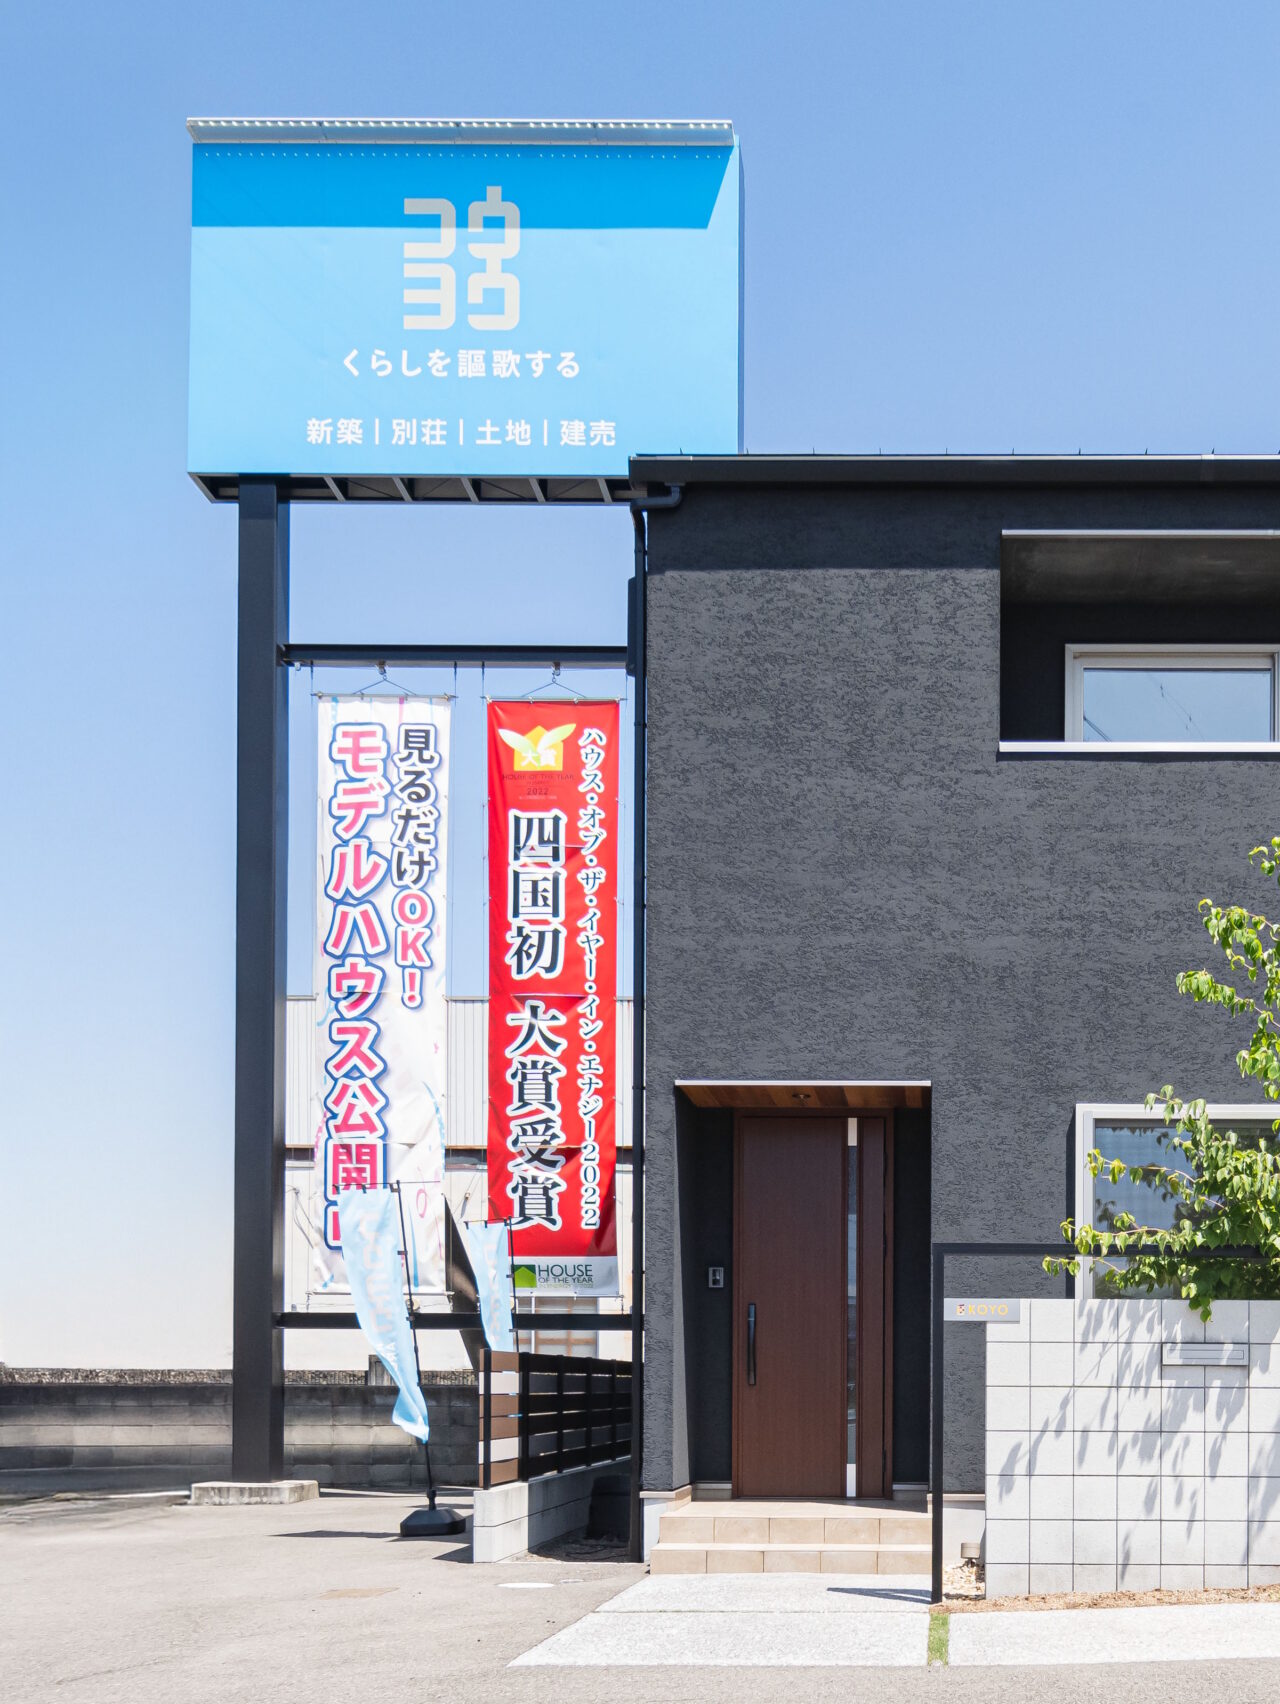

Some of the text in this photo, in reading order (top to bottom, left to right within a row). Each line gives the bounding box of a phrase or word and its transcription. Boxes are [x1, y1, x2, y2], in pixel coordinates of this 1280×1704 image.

[343, 349, 581, 379] くらしを謳歌する
[305, 418, 617, 447] 新築 別荘 土地 建売
[395, 726, 438, 1007] 見るだけOK!
[329, 726, 388, 1247] モデルハウス公開
[538, 1264, 593, 1277] HOUSE
